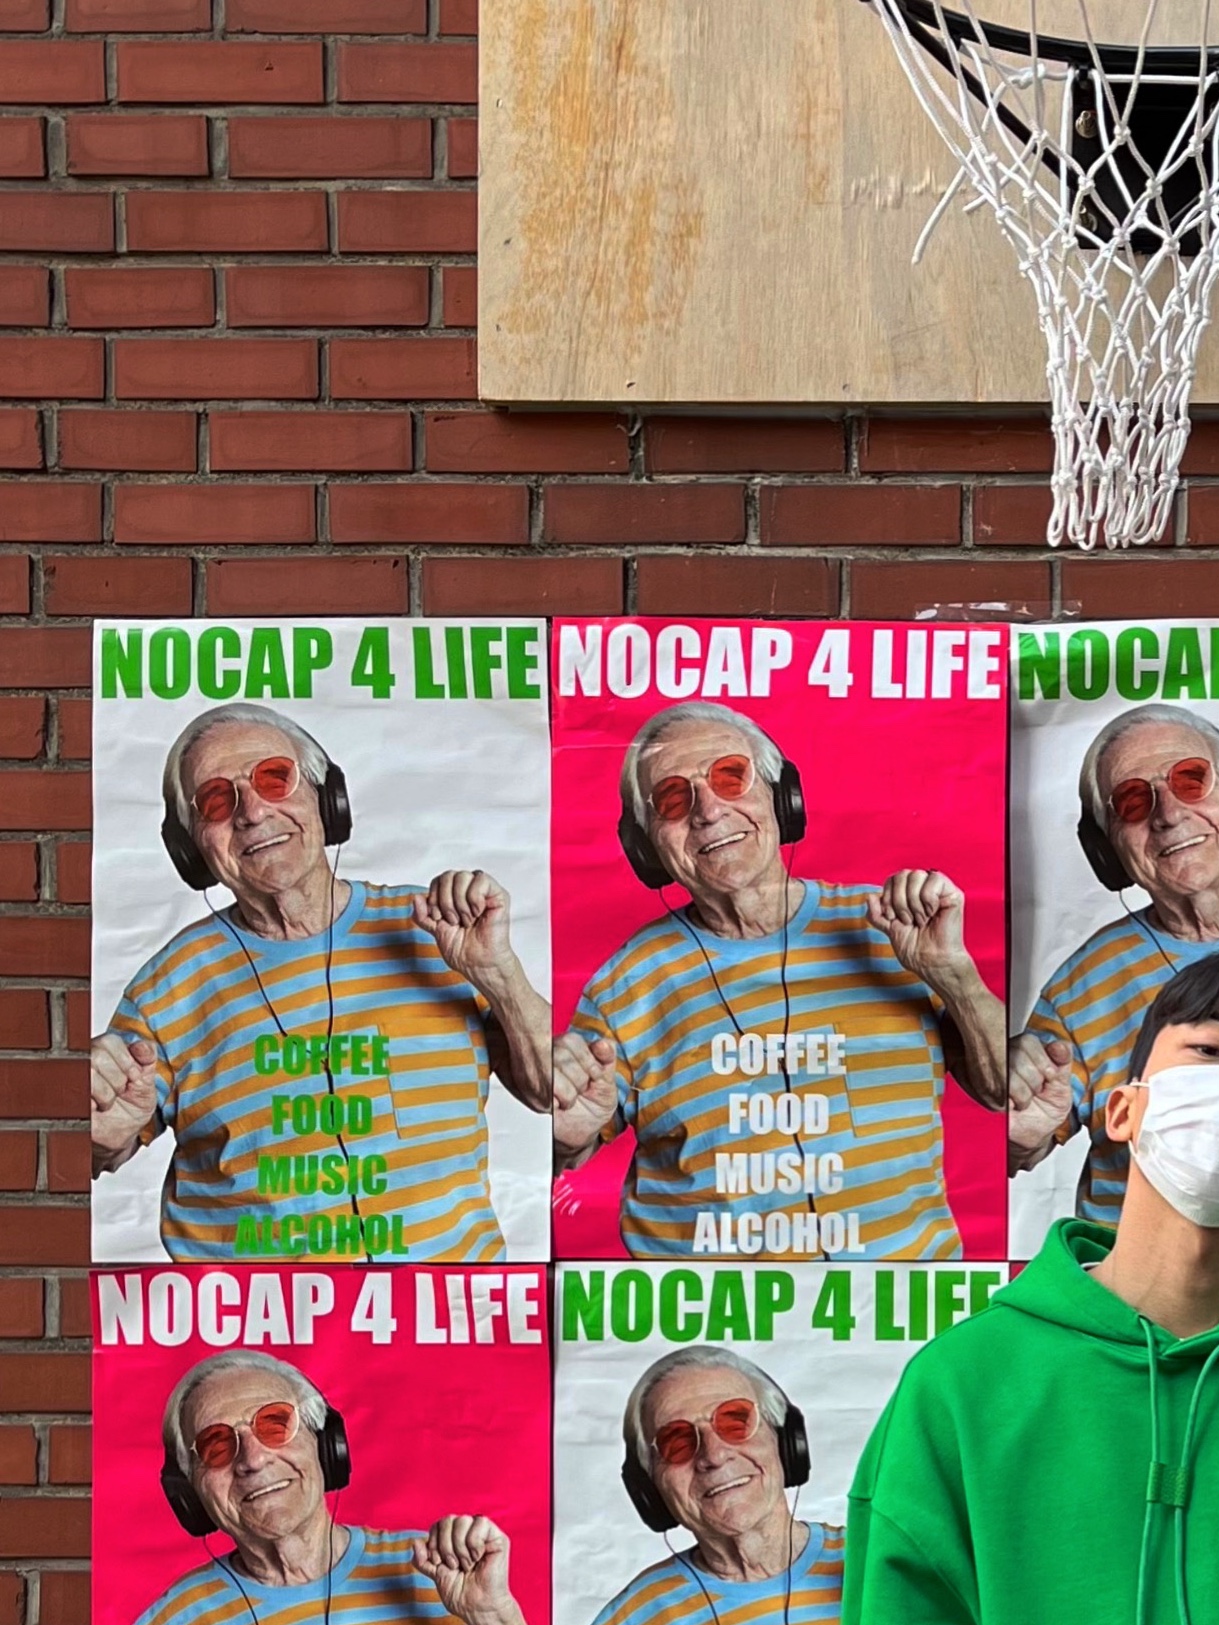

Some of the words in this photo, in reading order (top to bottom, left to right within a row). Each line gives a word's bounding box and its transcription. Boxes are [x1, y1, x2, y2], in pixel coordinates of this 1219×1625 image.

[100, 626, 333, 701] NOCAP
[350, 627, 397, 699] 4
[413, 626, 541, 700] LIFE
[560, 625, 793, 699] NOCAP
[808, 629, 854, 698] 4
[872, 629, 1001, 698] LIFE
[253, 1033, 390, 1077] COFFEE
[711, 1033, 847, 1076] COFFEE
[271, 1093, 373, 1136] FOOD
[728, 1093, 830, 1135] FOOD
[257, 1153, 388, 1197] MUSIC
[715, 1153, 845, 1195] MUSIC
[234, 1213, 409, 1257] ALCOHOL
[692, 1211, 866, 1256] ALCOHOL
[100, 1272, 336, 1347] NOCAP
[351, 1272, 397, 1345] 4
[415, 1272, 542, 1345] LIFE
[562, 1268, 801, 1344] NOCAP
[811, 1269, 857, 1342] 4
